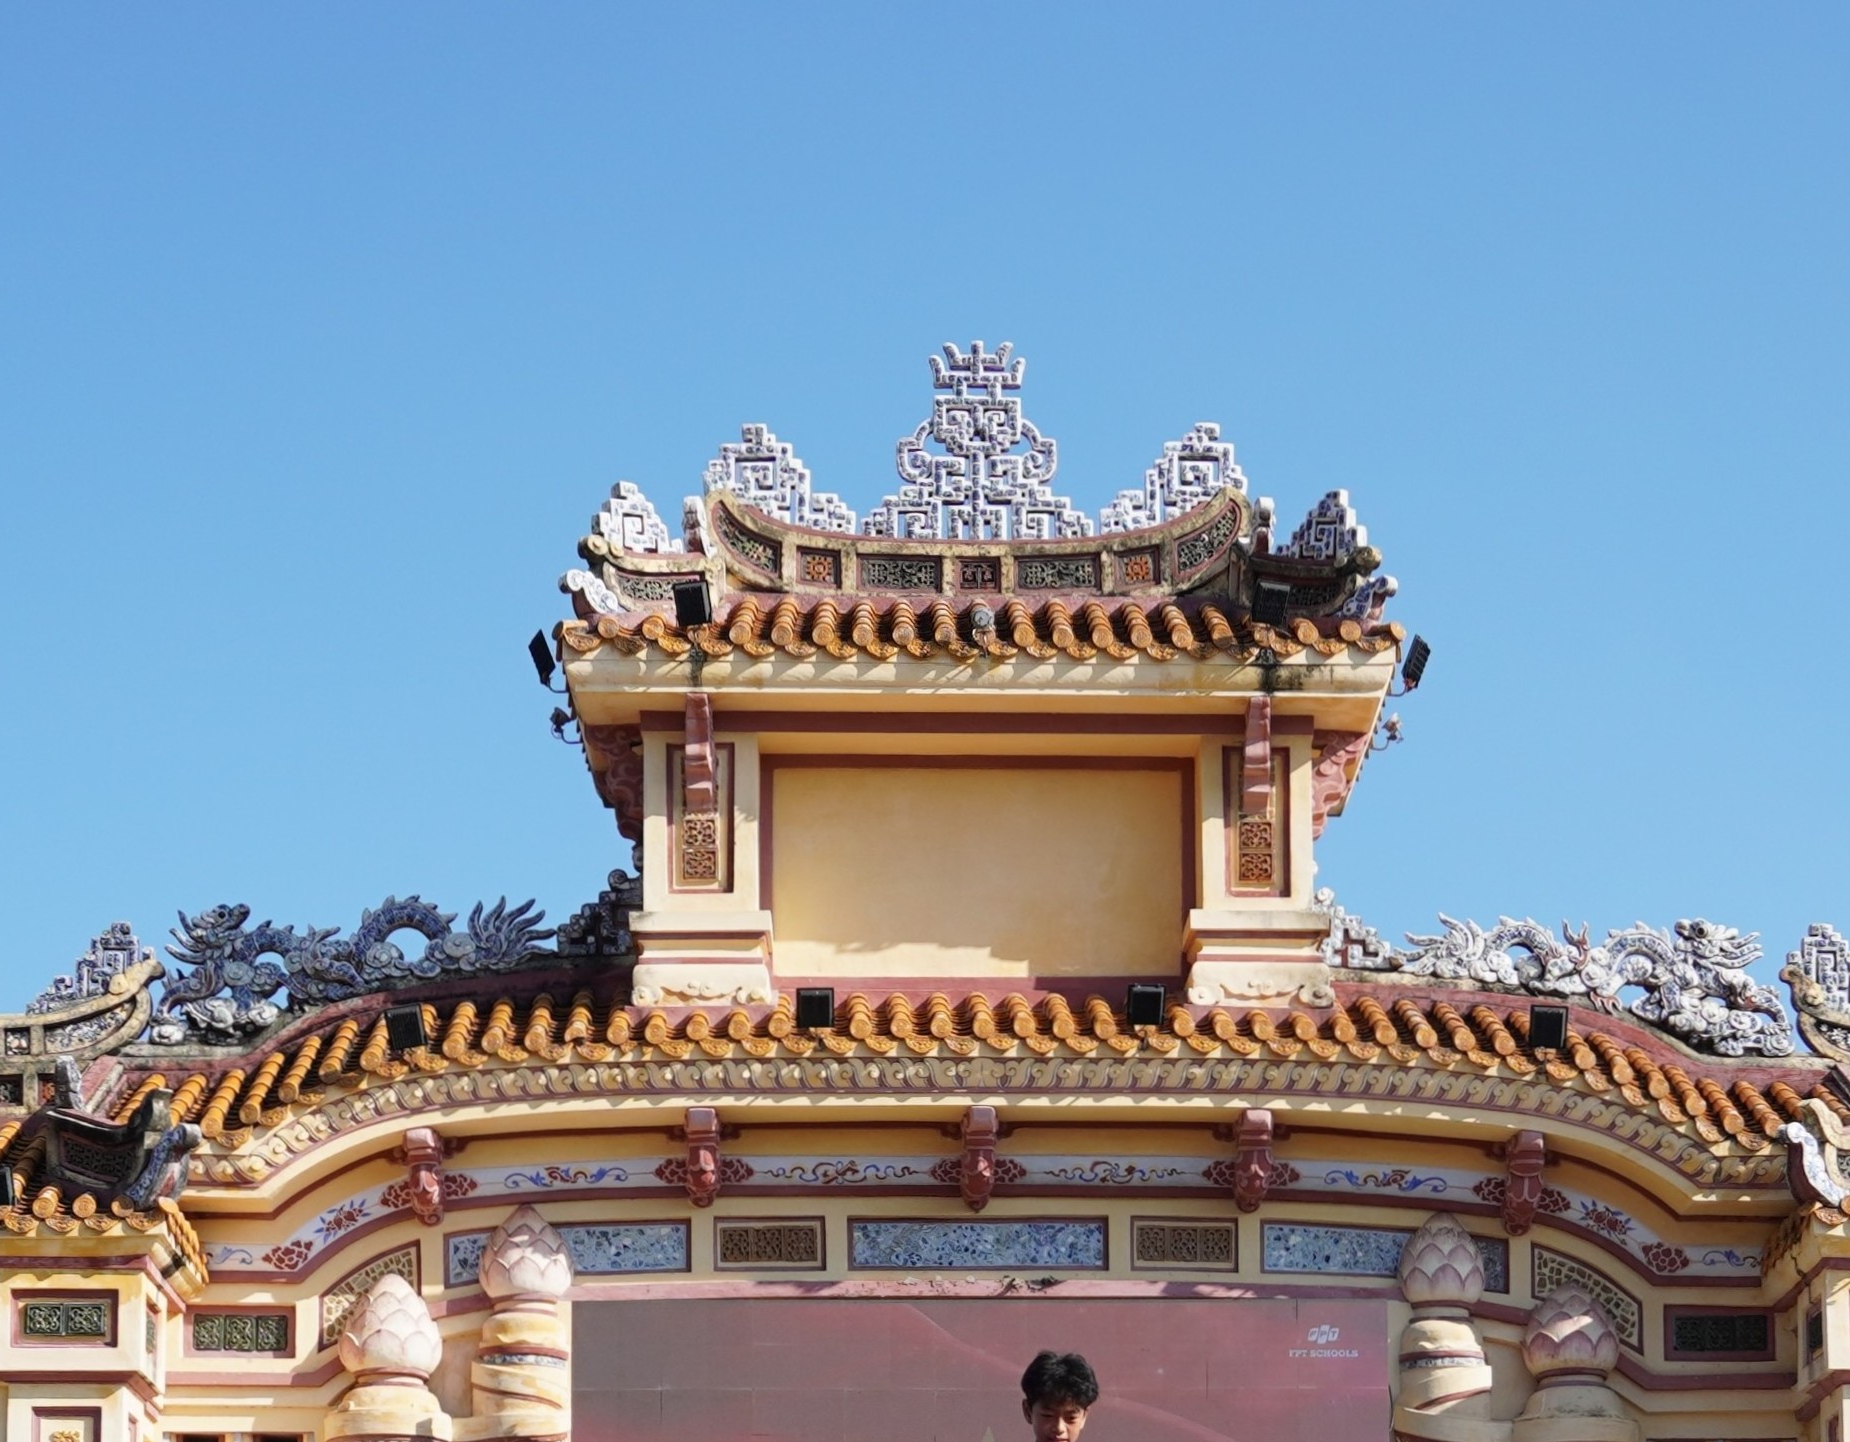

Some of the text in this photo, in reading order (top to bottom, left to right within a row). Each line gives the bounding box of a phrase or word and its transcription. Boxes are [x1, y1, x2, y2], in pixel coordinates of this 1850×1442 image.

[1308, 1324, 1339, 1344] FPT
[1289, 1349, 1359, 1358] FPT SCHOOLS
